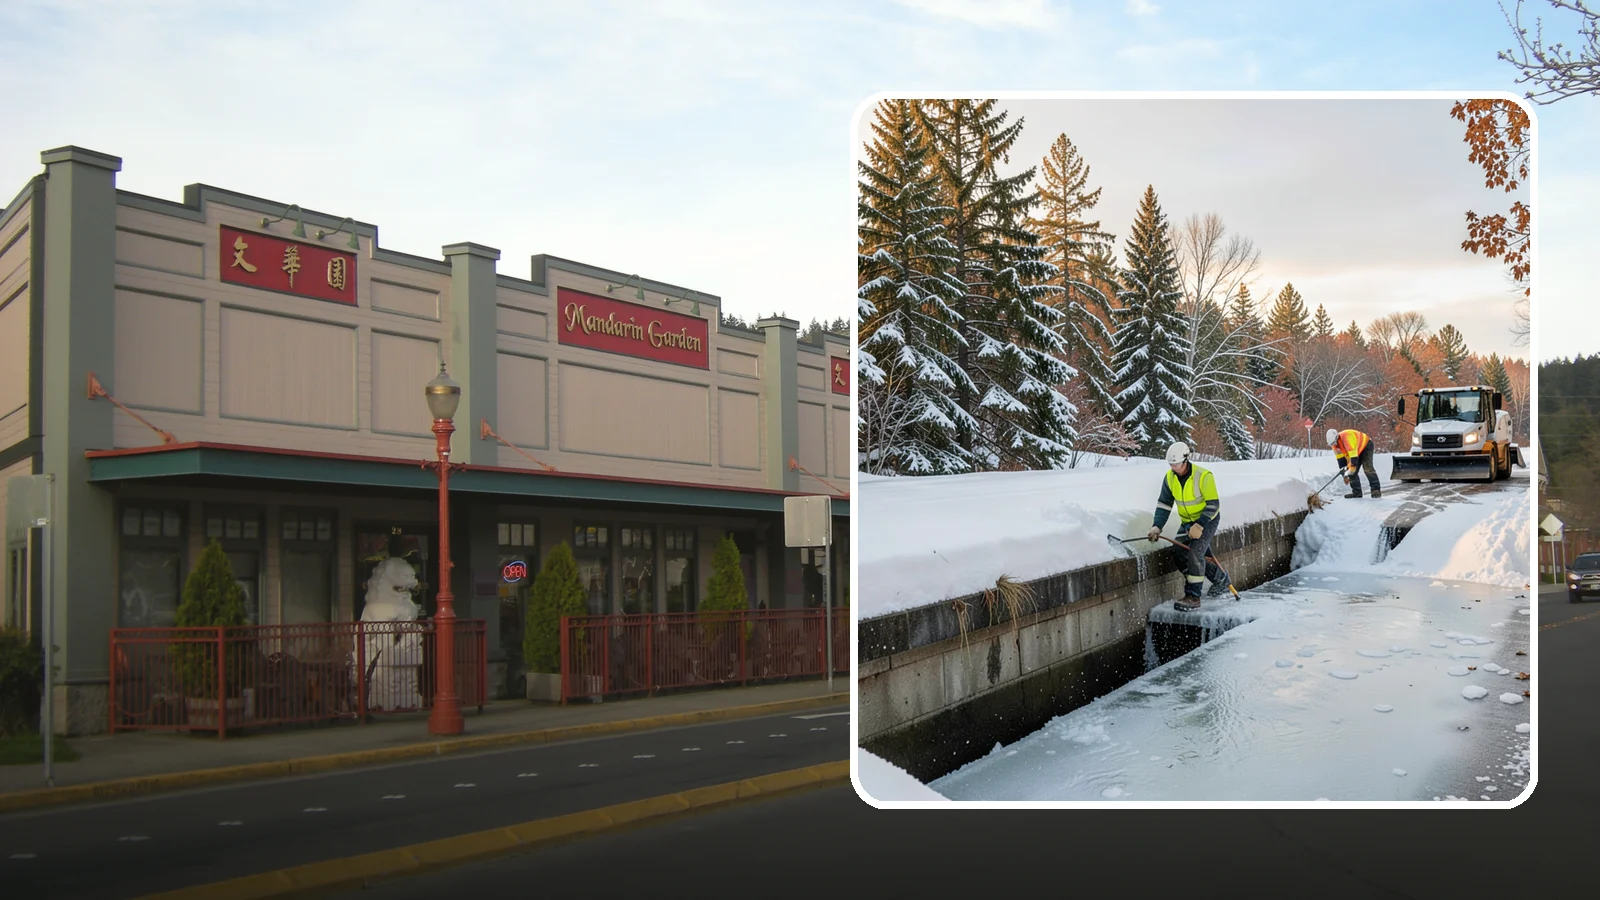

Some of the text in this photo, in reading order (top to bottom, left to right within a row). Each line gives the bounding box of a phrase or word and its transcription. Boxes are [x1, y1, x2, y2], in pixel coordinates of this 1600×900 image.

[231, 236, 346, 291] 文華園
[565, 302, 702, 352] Mandarin Garden
[835, 362, 846, 386] 文
[503, 565, 528, 578] OPEN
